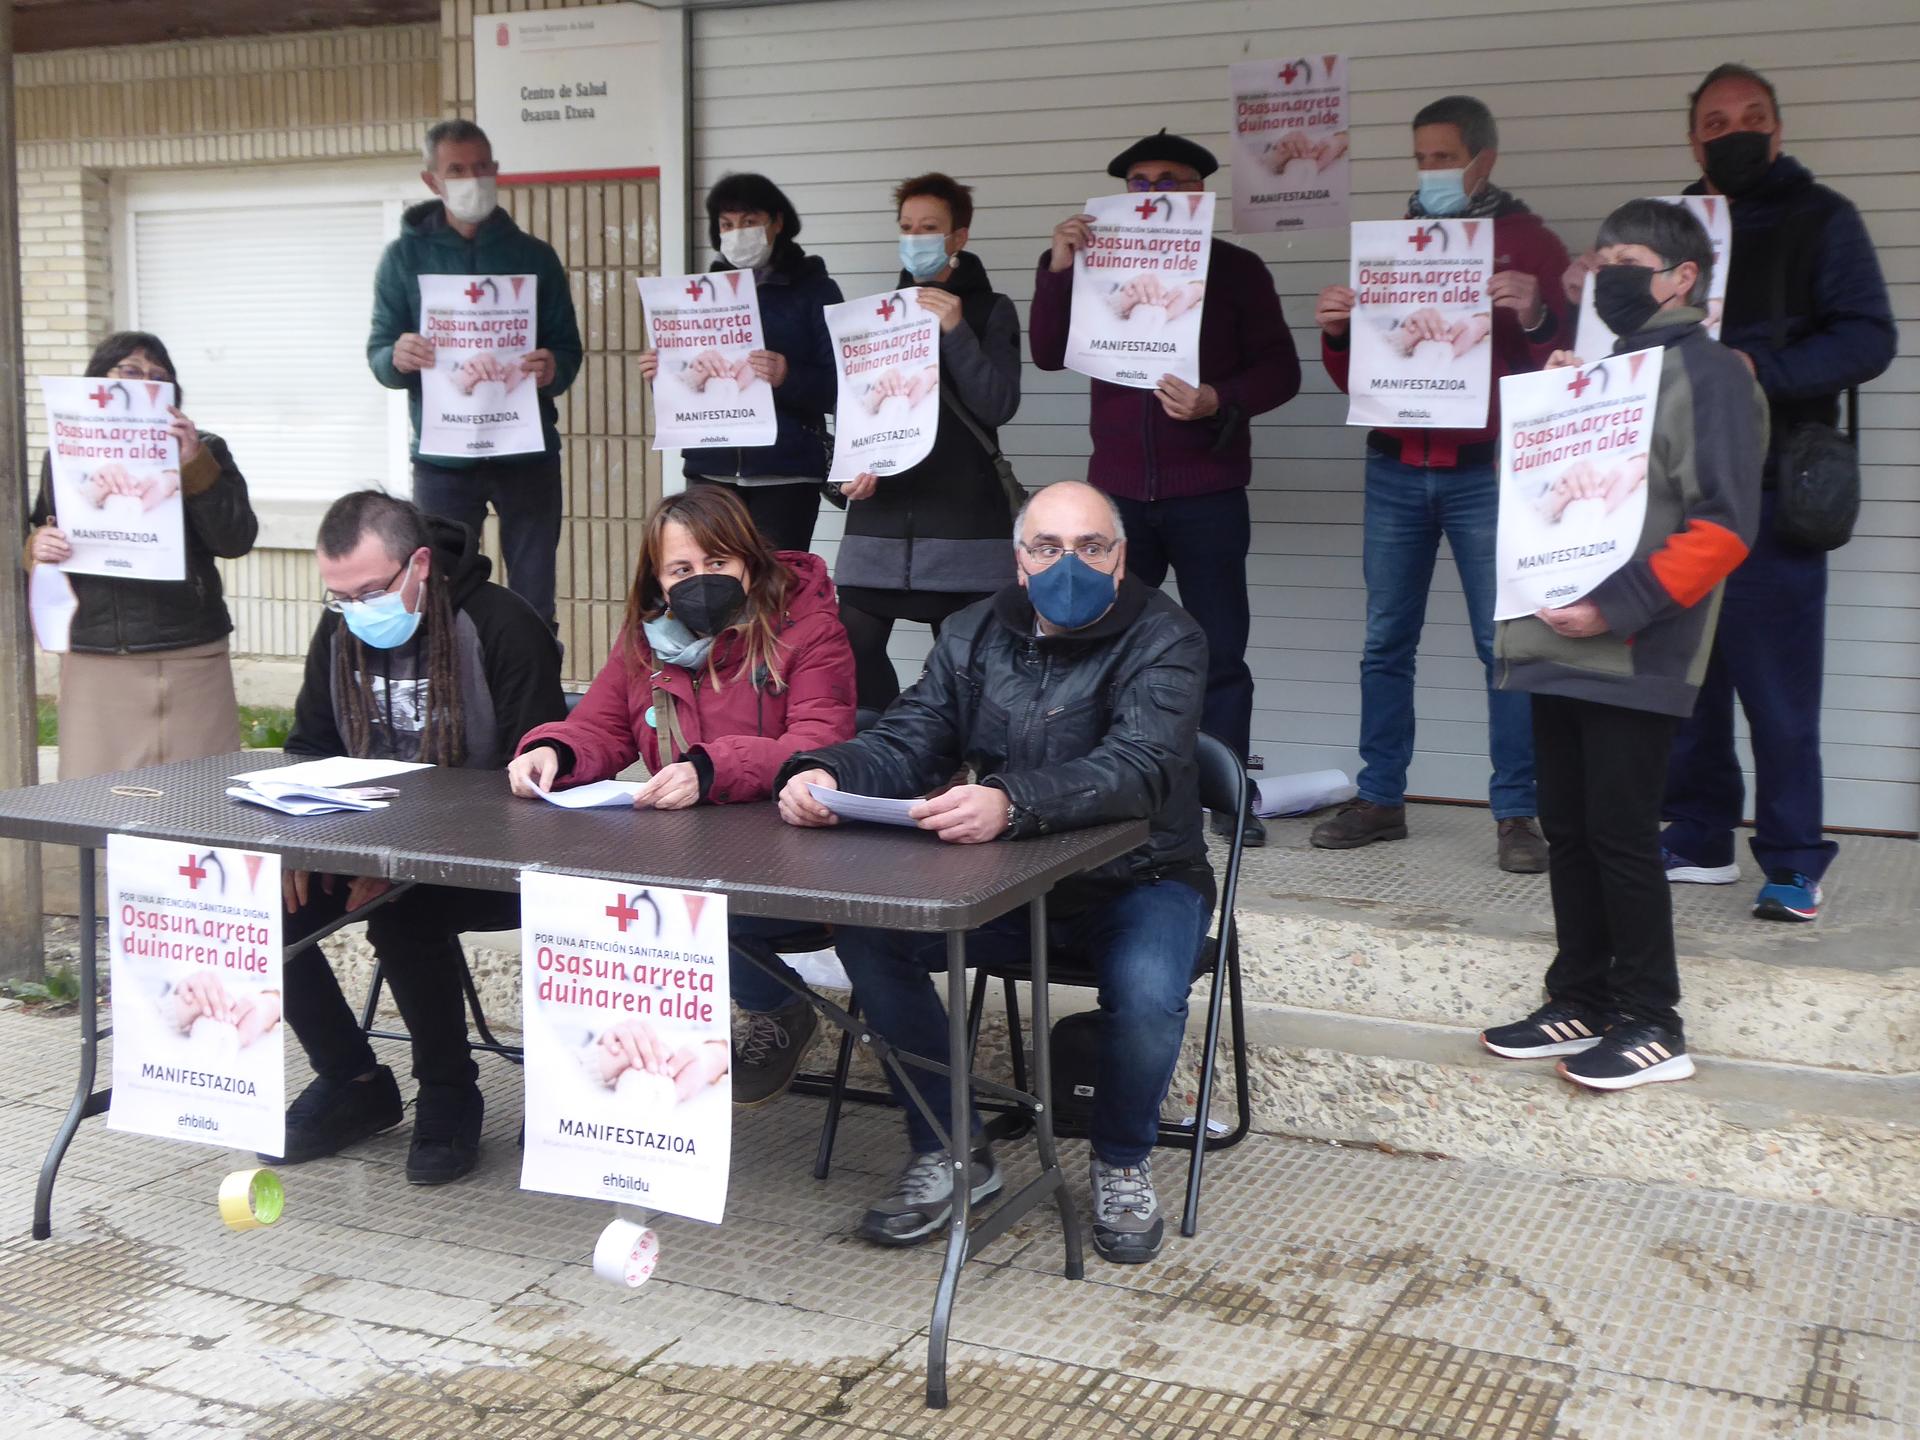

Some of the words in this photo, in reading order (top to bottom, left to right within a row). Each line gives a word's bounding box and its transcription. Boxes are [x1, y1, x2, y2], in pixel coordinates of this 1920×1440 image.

[521, 86, 555, 100] Centro
[559, 84, 572, 98] de
[576, 81, 607, 97] Salud
[521, 108, 560, 122] Osasun
[565, 106, 595, 120] Etxea
[1086, 234, 1144, 250] Osasun
[1148, 237, 1200, 253] arreta
[1086, 251, 1158, 269] duinaren
[1163, 254, 1198, 271] alde
[1359, 269, 1420, 285] Osasun
[1425, 269, 1481, 286] arreta
[1360, 286, 1438, 305] duinaren
[1443, 286, 1480, 304] alde
[427, 317, 478, 331] Osasun
[481, 317, 528, 332] arreta
[653, 316, 702, 331] Osasun
[704, 313, 751, 330] arreta
[429, 333, 493, 348] duinaren
[497, 332, 527, 347] alde
[656, 333, 716, 348] duinaren
[720, 329, 752, 344] alde
[842, 339, 890, 359] Osasun
[891, 328, 931, 348] arreta
[1089, 339, 1177, 353] MANIFESTAZIOA
[845, 354, 899, 376] duinaren
[902, 344, 929, 362] alde
[1371, 378, 1466, 391] MANIFESTAZIOA
[442, 411, 520, 424] MANIFESTAZIOA
[676, 408, 755, 422] MANIFESTAZIOA
[55, 422, 109, 440] Osasun
[112, 426, 167, 442] arreta
[1513, 419, 1577, 449] Osasun
[1580, 405, 1643, 434] arreta
[851, 427, 921, 449] MANIFESTAZIOA
[57, 440, 124, 459] duinaren
[129, 443, 168, 460] alde
[1513, 439, 1592, 473] duinaren
[1597, 427, 1639, 452] alde
[72, 529, 158, 544] MANIFESTAZIOA
[1516, 539, 1617, 571] MANIFESTAZIOA
[120, 891, 135, 901] POR
[138, 894, 154, 904] UNA
[156, 896, 197, 909] ATENCIÓN
[199, 902, 241, 915] SANITARIA
[243, 908, 270, 920] DIGNA
[121, 904, 198, 934] Osasun
[203, 921, 269, 946] arreta
[124, 931, 218, 966] duinaren
[224, 946, 268, 974] alde
[535, 933, 553, 944] POR
[556, 936, 576, 947] UNA
[578, 938, 626, 954] ATENCIÓN
[629, 945, 680, 961] SANITARIA
[683, 952, 715, 965] DIGNA
[537, 946, 625, 982] Osasun
[633, 962, 714, 993] arreta
[538, 975, 652, 1015] duinaren
[659, 993, 713, 1023] alde
[141, 1063, 257, 1097] MANIFESTAZIOA
[177, 1113, 219, 1132] ehbildu
[558, 1118, 696, 1156] MANIFESTAZIOA
[602, 1173, 650, 1193] ehbildu
